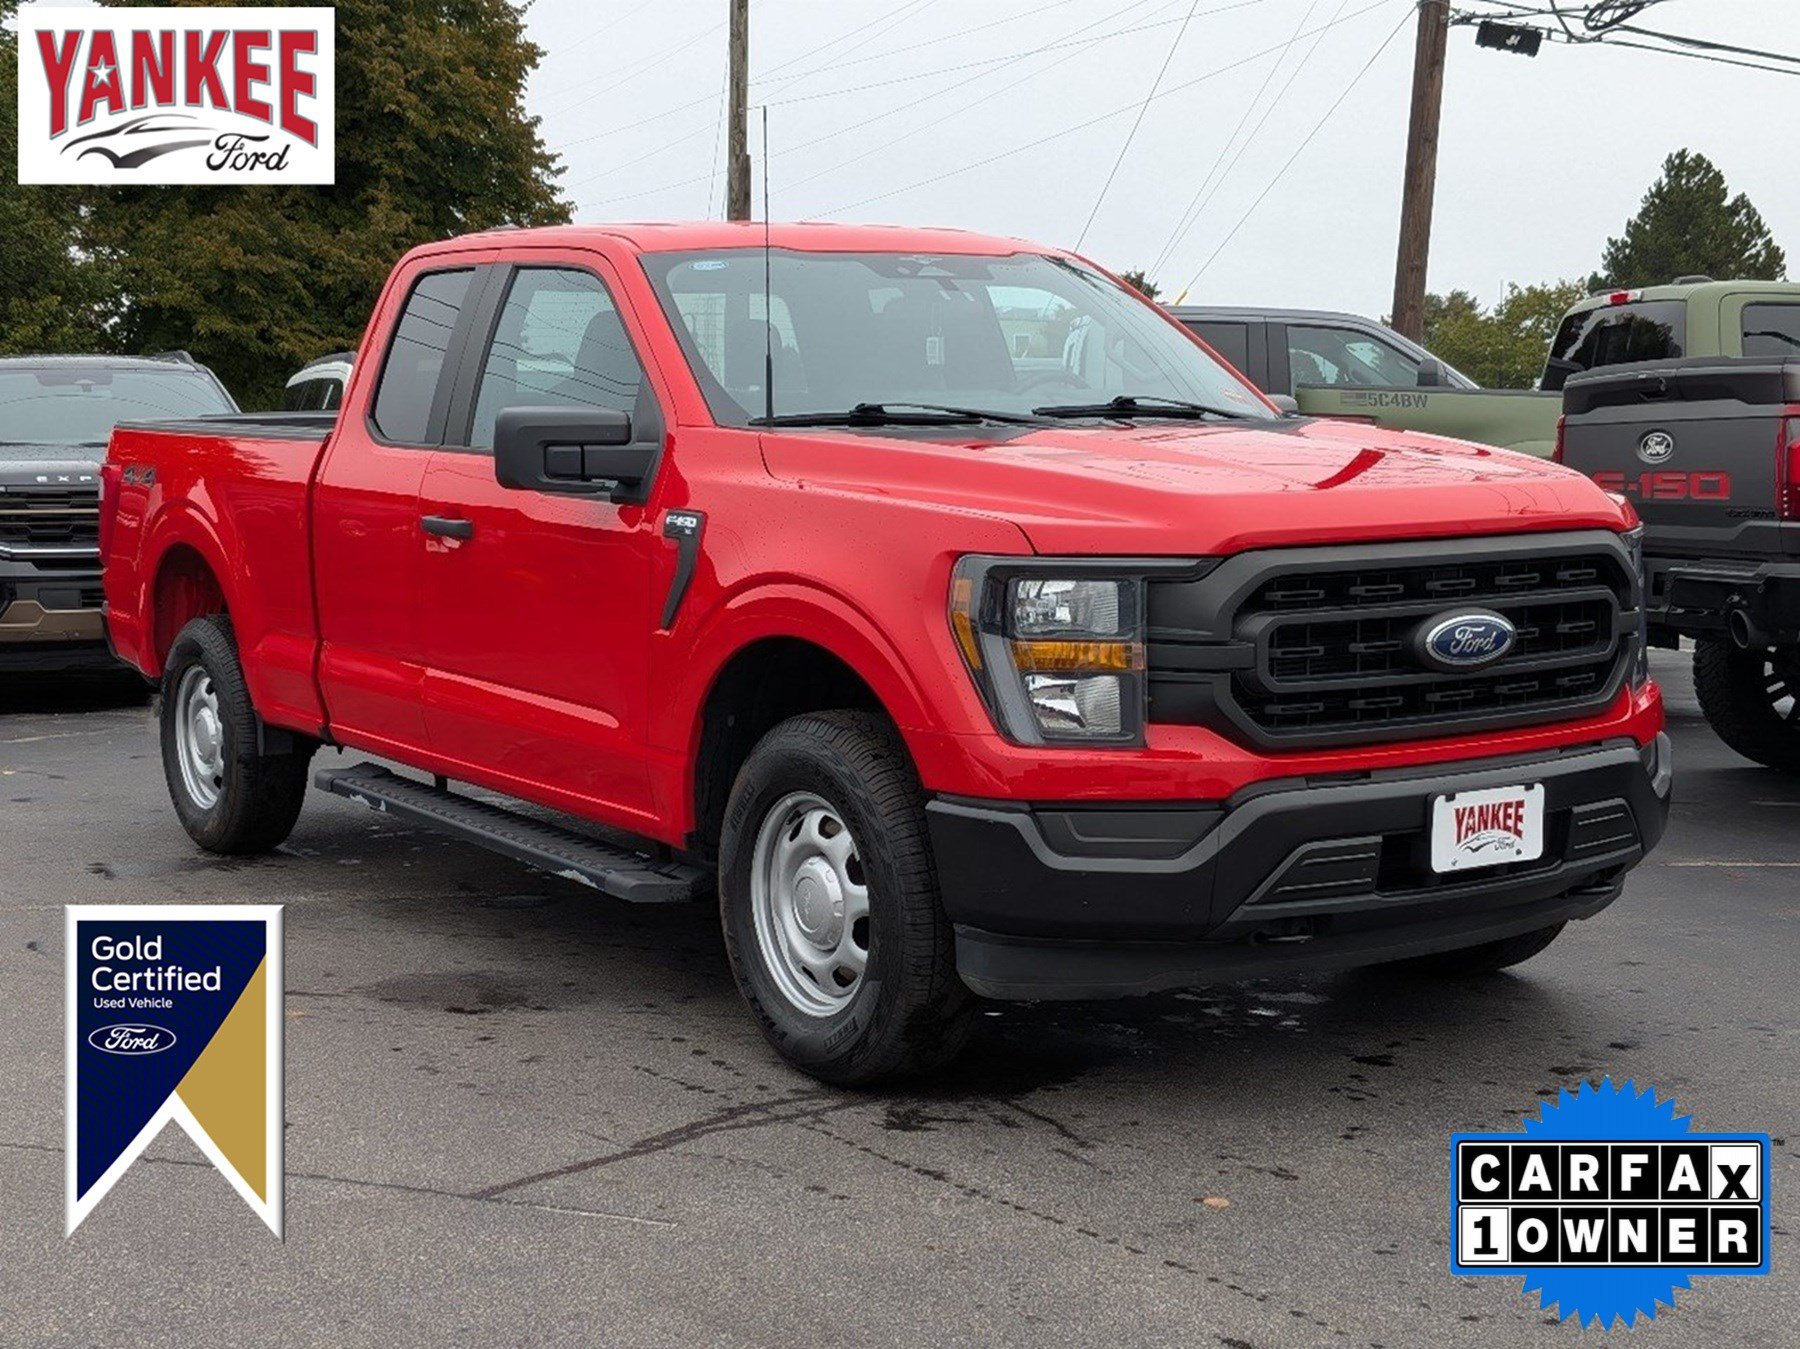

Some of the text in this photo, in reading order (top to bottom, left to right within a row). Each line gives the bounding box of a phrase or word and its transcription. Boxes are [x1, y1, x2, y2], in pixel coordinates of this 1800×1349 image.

[1593, 470, 1731, 500] F-150
[1450, 626, 1498, 654] Ford
[1454, 799, 1525, 846] YANKEE
